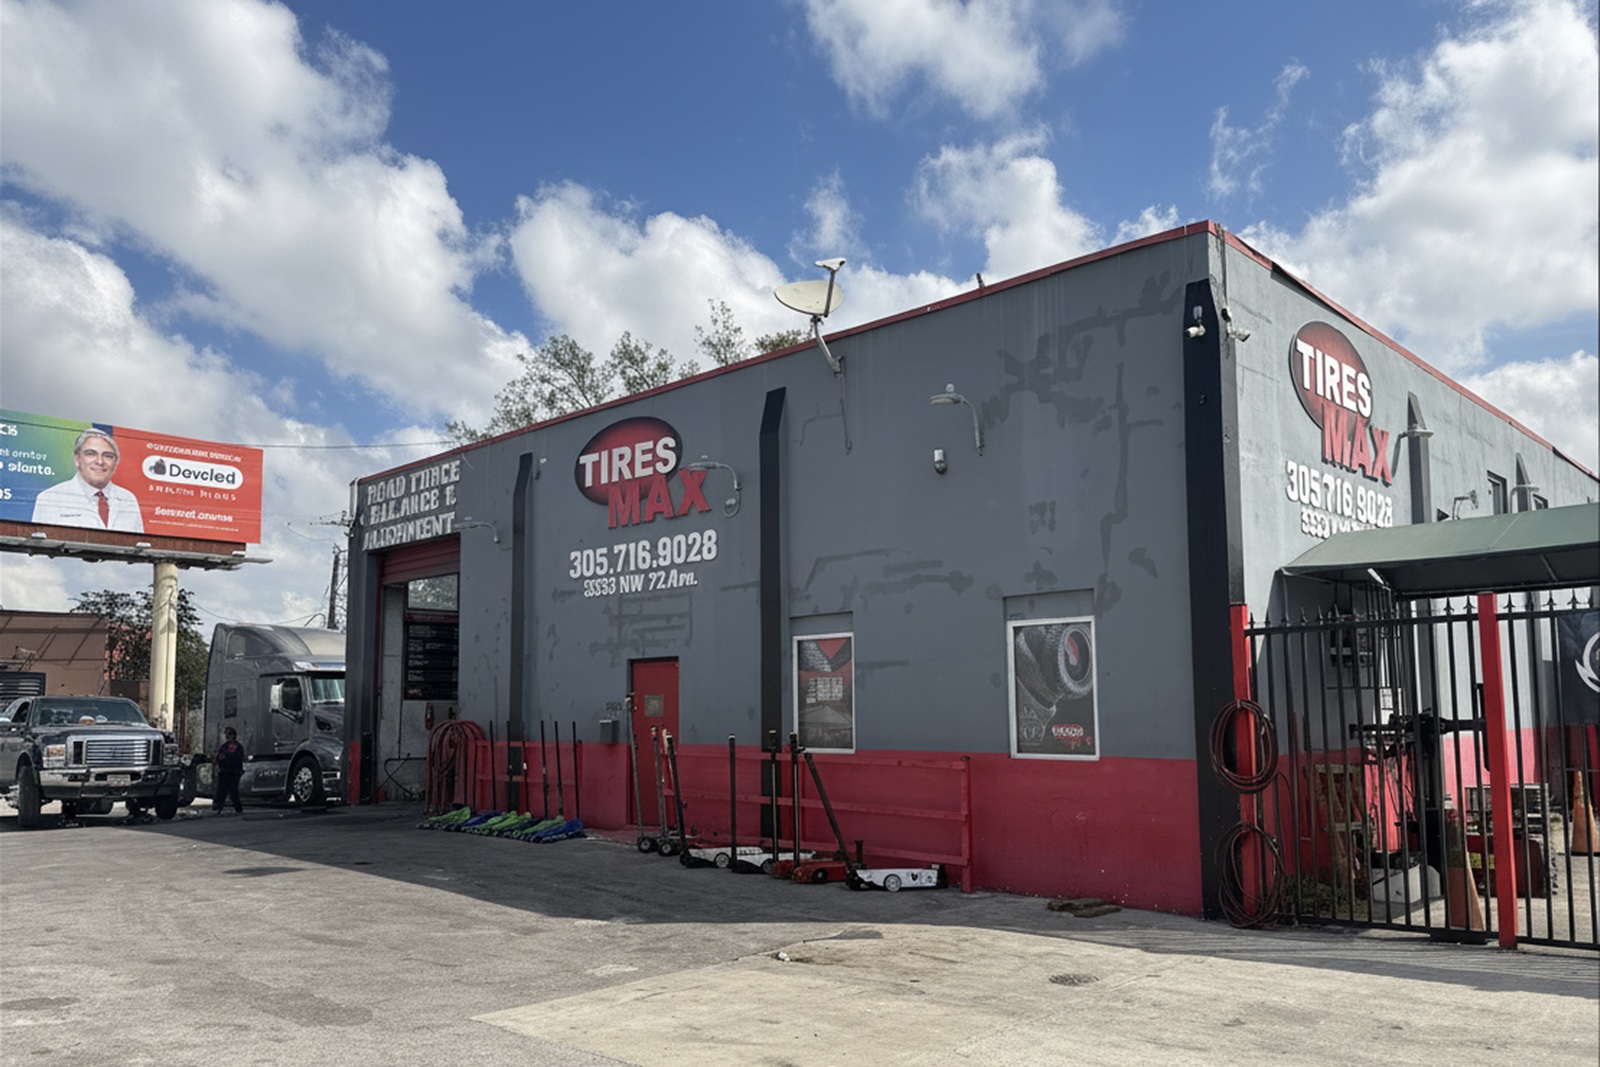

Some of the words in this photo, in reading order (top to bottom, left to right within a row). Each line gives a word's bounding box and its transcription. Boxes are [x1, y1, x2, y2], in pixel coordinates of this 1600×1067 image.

[1296, 338, 1371, 418] TIRES
[579, 436, 677, 488] TIRES
[1322, 402, 1392, 486] MAX
[608, 467, 712, 529] MAX
[569, 529, 717, 578] 305.716.9028
[619, 574, 645, 594] NW
